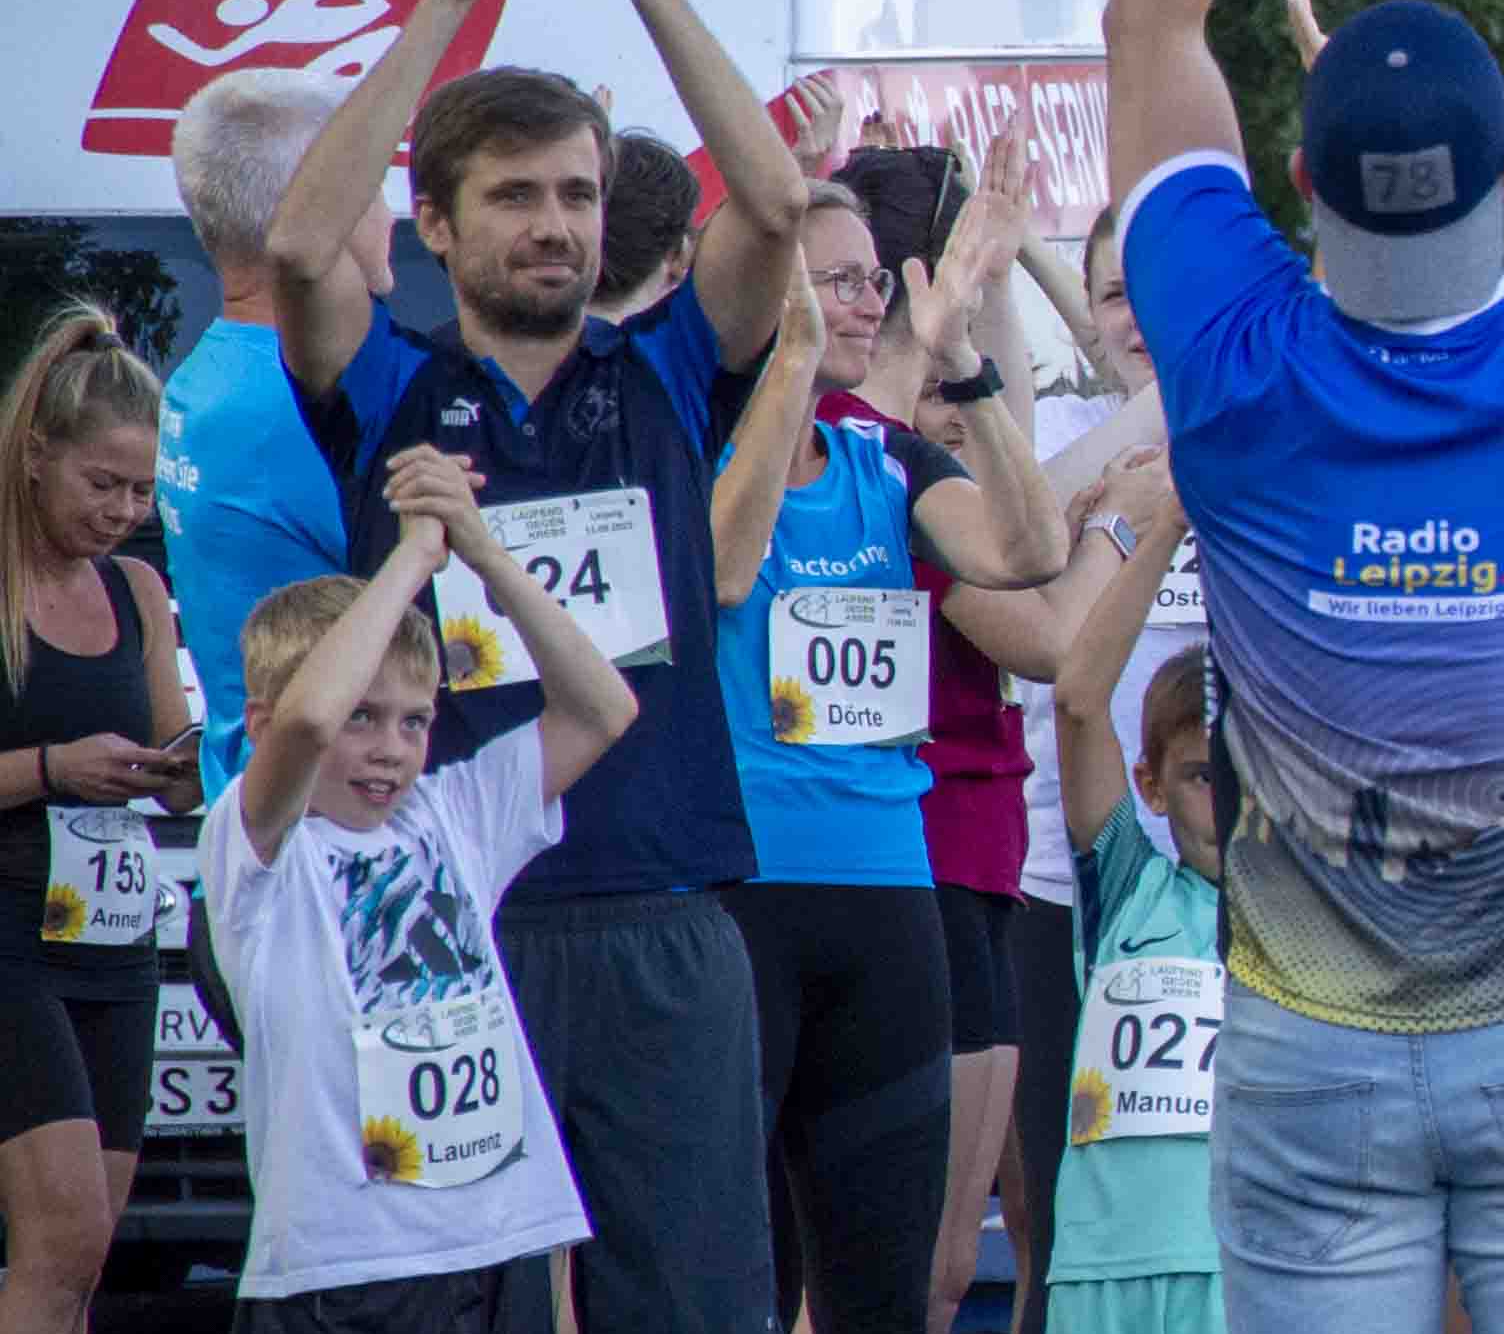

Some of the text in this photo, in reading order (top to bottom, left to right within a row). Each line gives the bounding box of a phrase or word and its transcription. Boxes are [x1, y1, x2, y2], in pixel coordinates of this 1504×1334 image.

[1352, 520, 1481, 554] Radio
[484, 548, 611, 617] 24
[1156, 588, 1204, 608] Ost
[1328, 598, 1361, 615] Wir
[1366, 602, 1431, 617] lieben
[808, 636, 896, 689] 005
[828, 702, 885, 727] Dörte
[88, 849, 146, 895] 153
[1112, 1013, 1223, 1072] 027
[408, 1046, 500, 1121] 028
[1115, 1090, 1210, 1116] Manue
[427, 1132, 502, 1163] Laurenz
